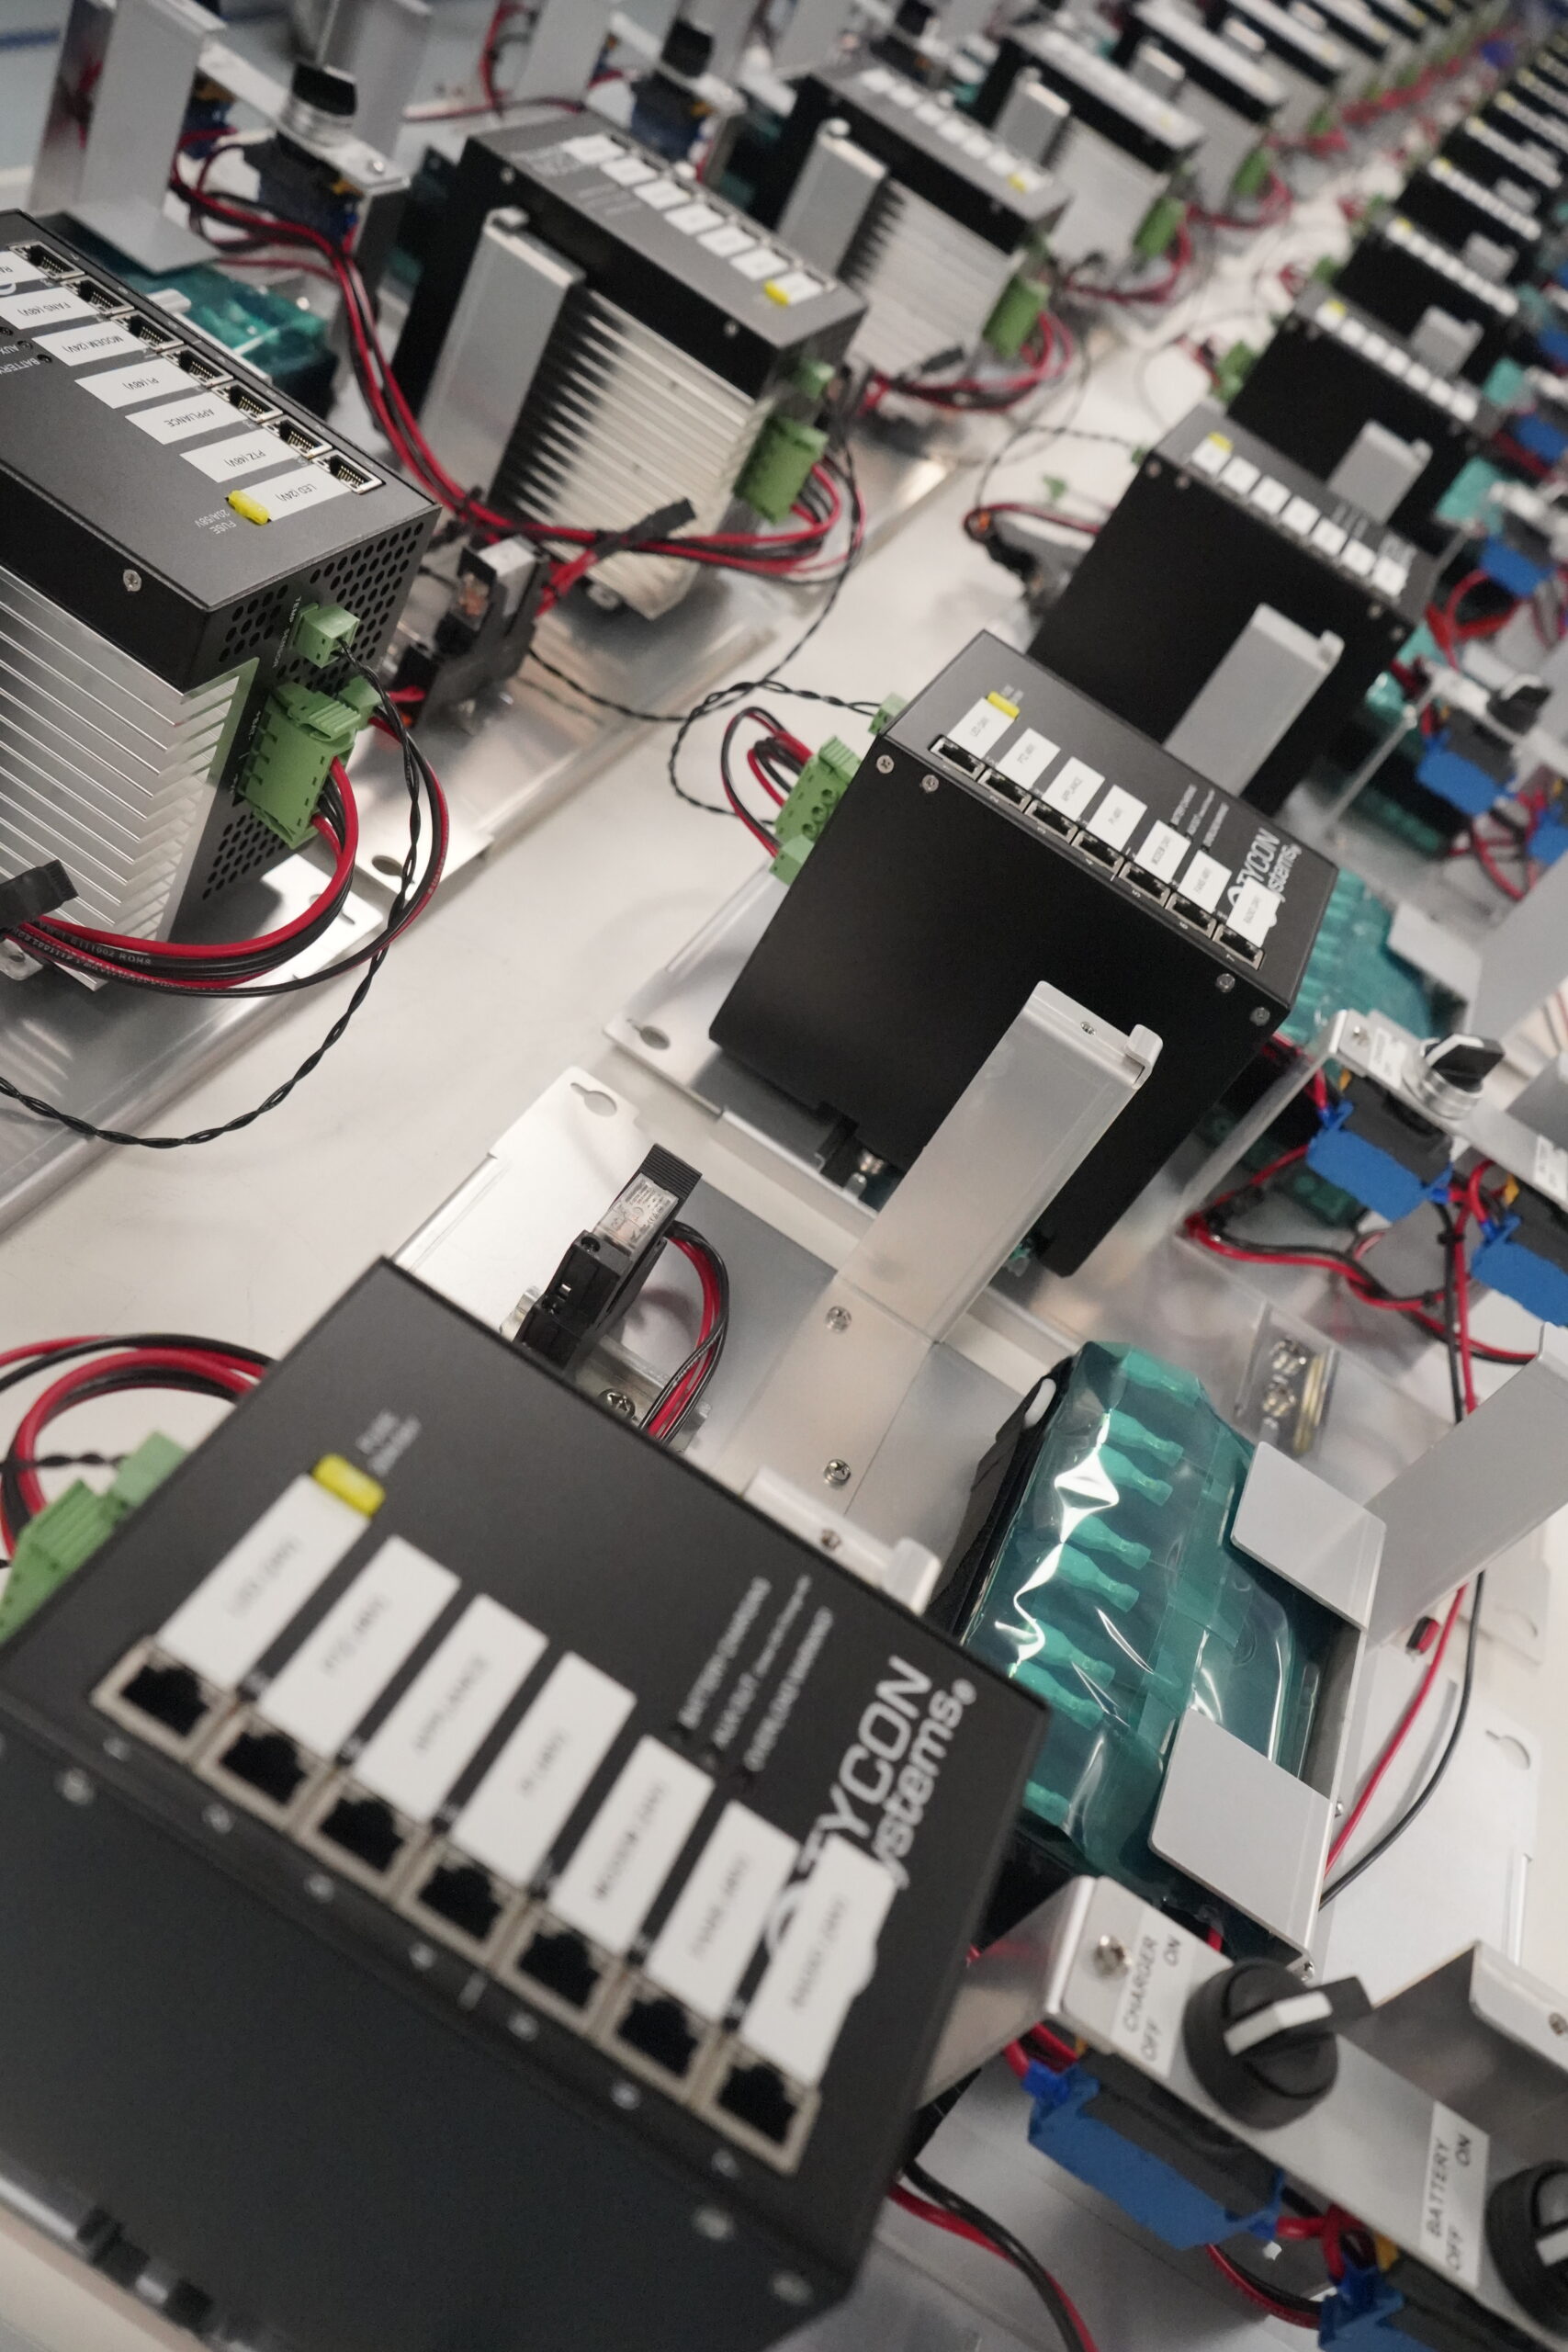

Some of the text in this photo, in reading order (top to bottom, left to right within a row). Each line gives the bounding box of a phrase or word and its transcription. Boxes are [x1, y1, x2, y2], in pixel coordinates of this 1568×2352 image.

[45, 301, 72, 312] FANS
[89, 335, 124, 349] MODEM
[164, 409, 215, 428] APPLIANCE
[249, 448, 267, 460] PTZ
[276, 483, 318, 502] LED (24V)
[209, 520, 237, 535] FUSE
[798, 1656, 933, 1873] TYCON
[872, 1689, 961, 1889] ystems
[1122, 1936, 1157, 2032] CHARGER
[1141, 1934, 1181, 2062] OFF ON
[1426, 2138, 1450, 2238] BATTERY
[1446, 2133, 1471, 2270] OFF ON
